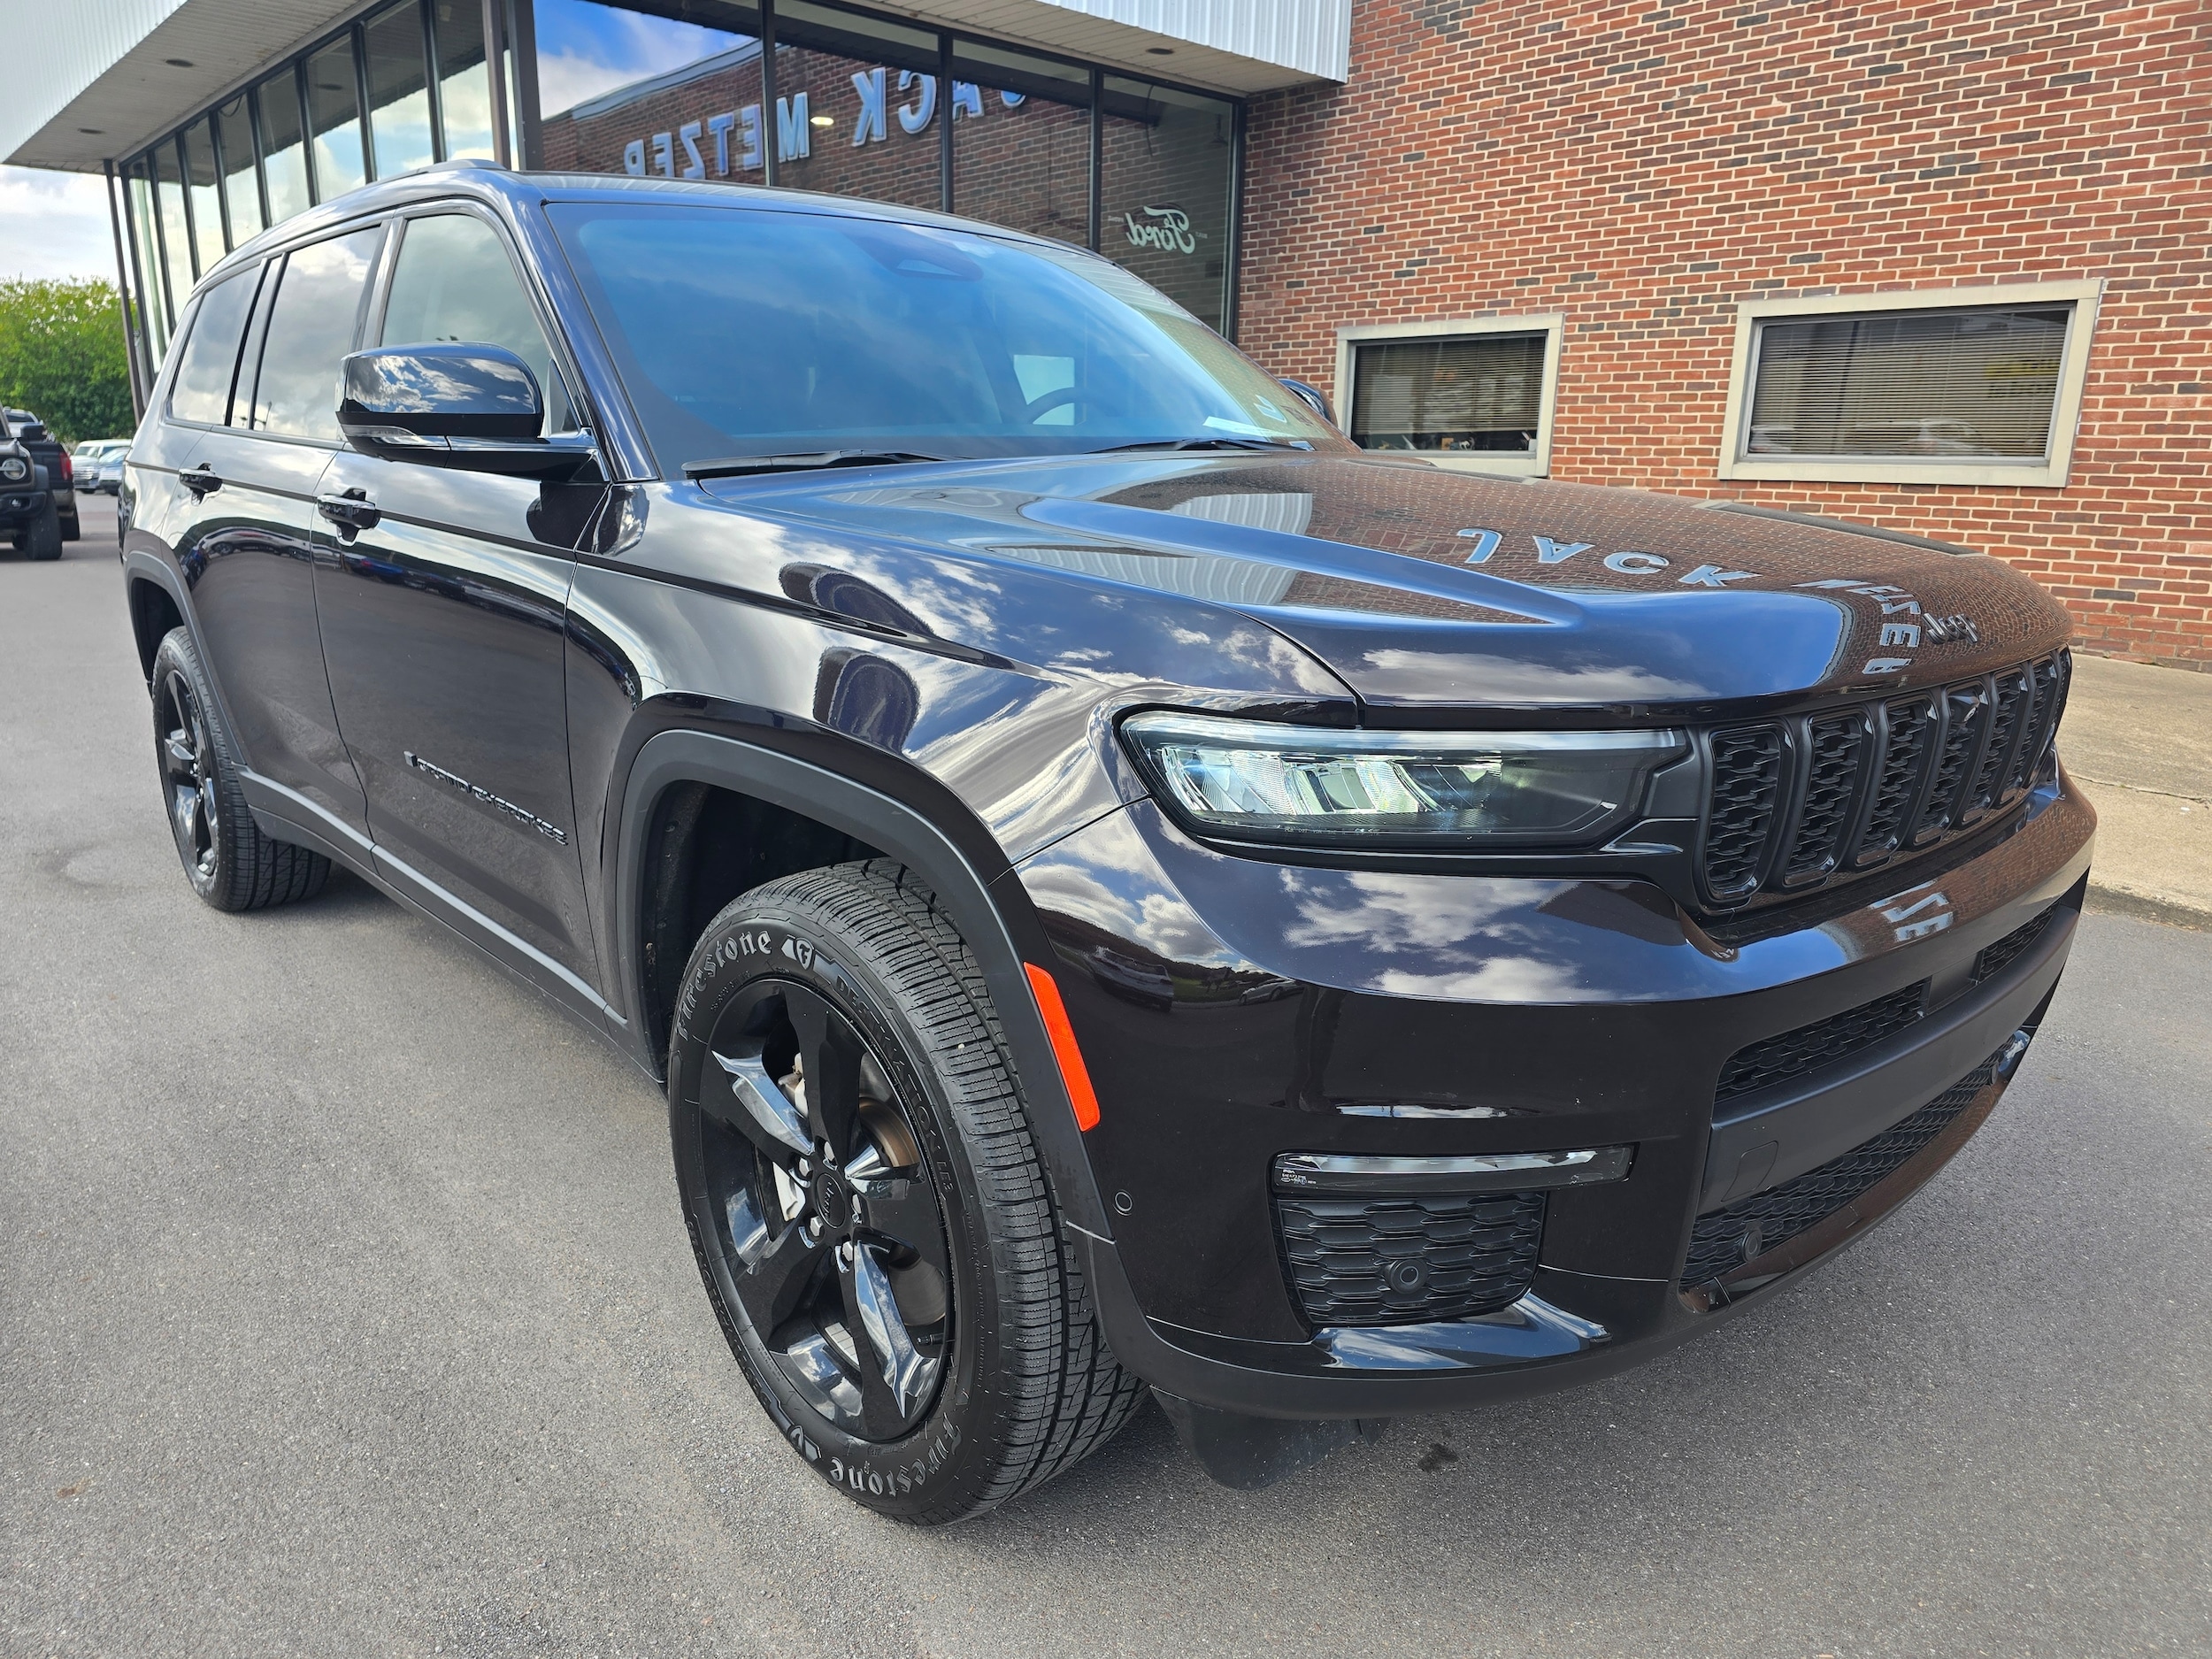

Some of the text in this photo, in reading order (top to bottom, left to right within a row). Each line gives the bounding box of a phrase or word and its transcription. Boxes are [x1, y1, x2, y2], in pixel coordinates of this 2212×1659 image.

[1922, 612, 1978, 646] Jeep
[675, 930, 772, 1041] Firestone
[829, 1411, 963, 1497] Firestone
